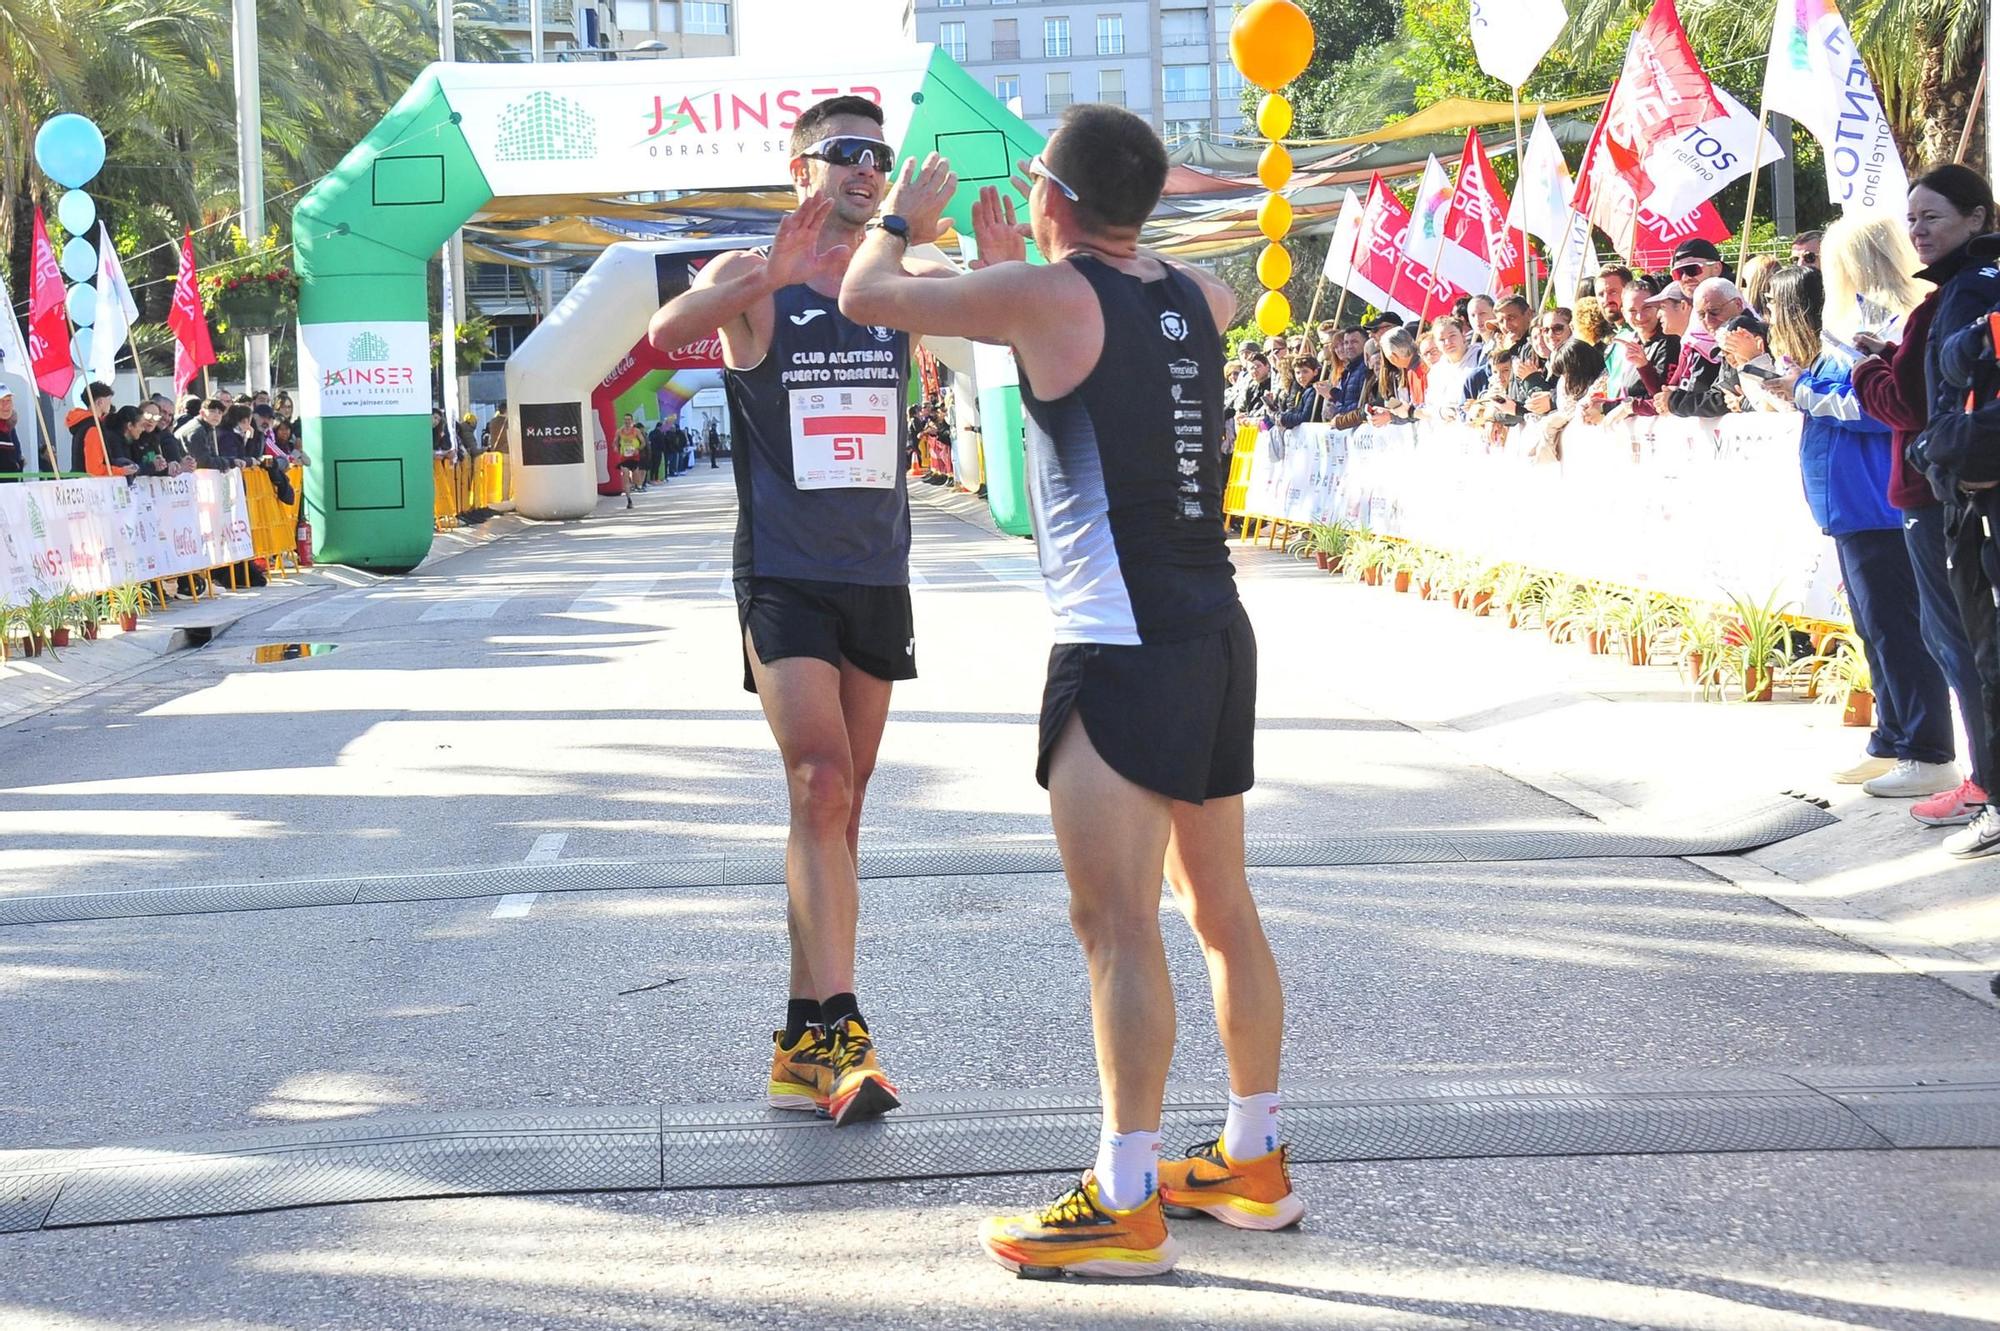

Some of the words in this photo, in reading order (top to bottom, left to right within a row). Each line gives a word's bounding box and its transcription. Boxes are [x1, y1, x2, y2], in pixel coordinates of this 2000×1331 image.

[648, 86, 881, 136] JAINS
[649, 143, 719, 157] OBRAS
[737, 142, 745, 153] Y
[792, 351, 825, 364] CLUB
[829, 350, 893, 364] ATLETISMO
[324, 367, 413, 386] JAINSER
[781, 369, 831, 383] PUERTO
[342, 399, 400, 407] www.jainser.com
[526, 425, 578, 437] MARCOS
[833, 437, 864, 460] 51
